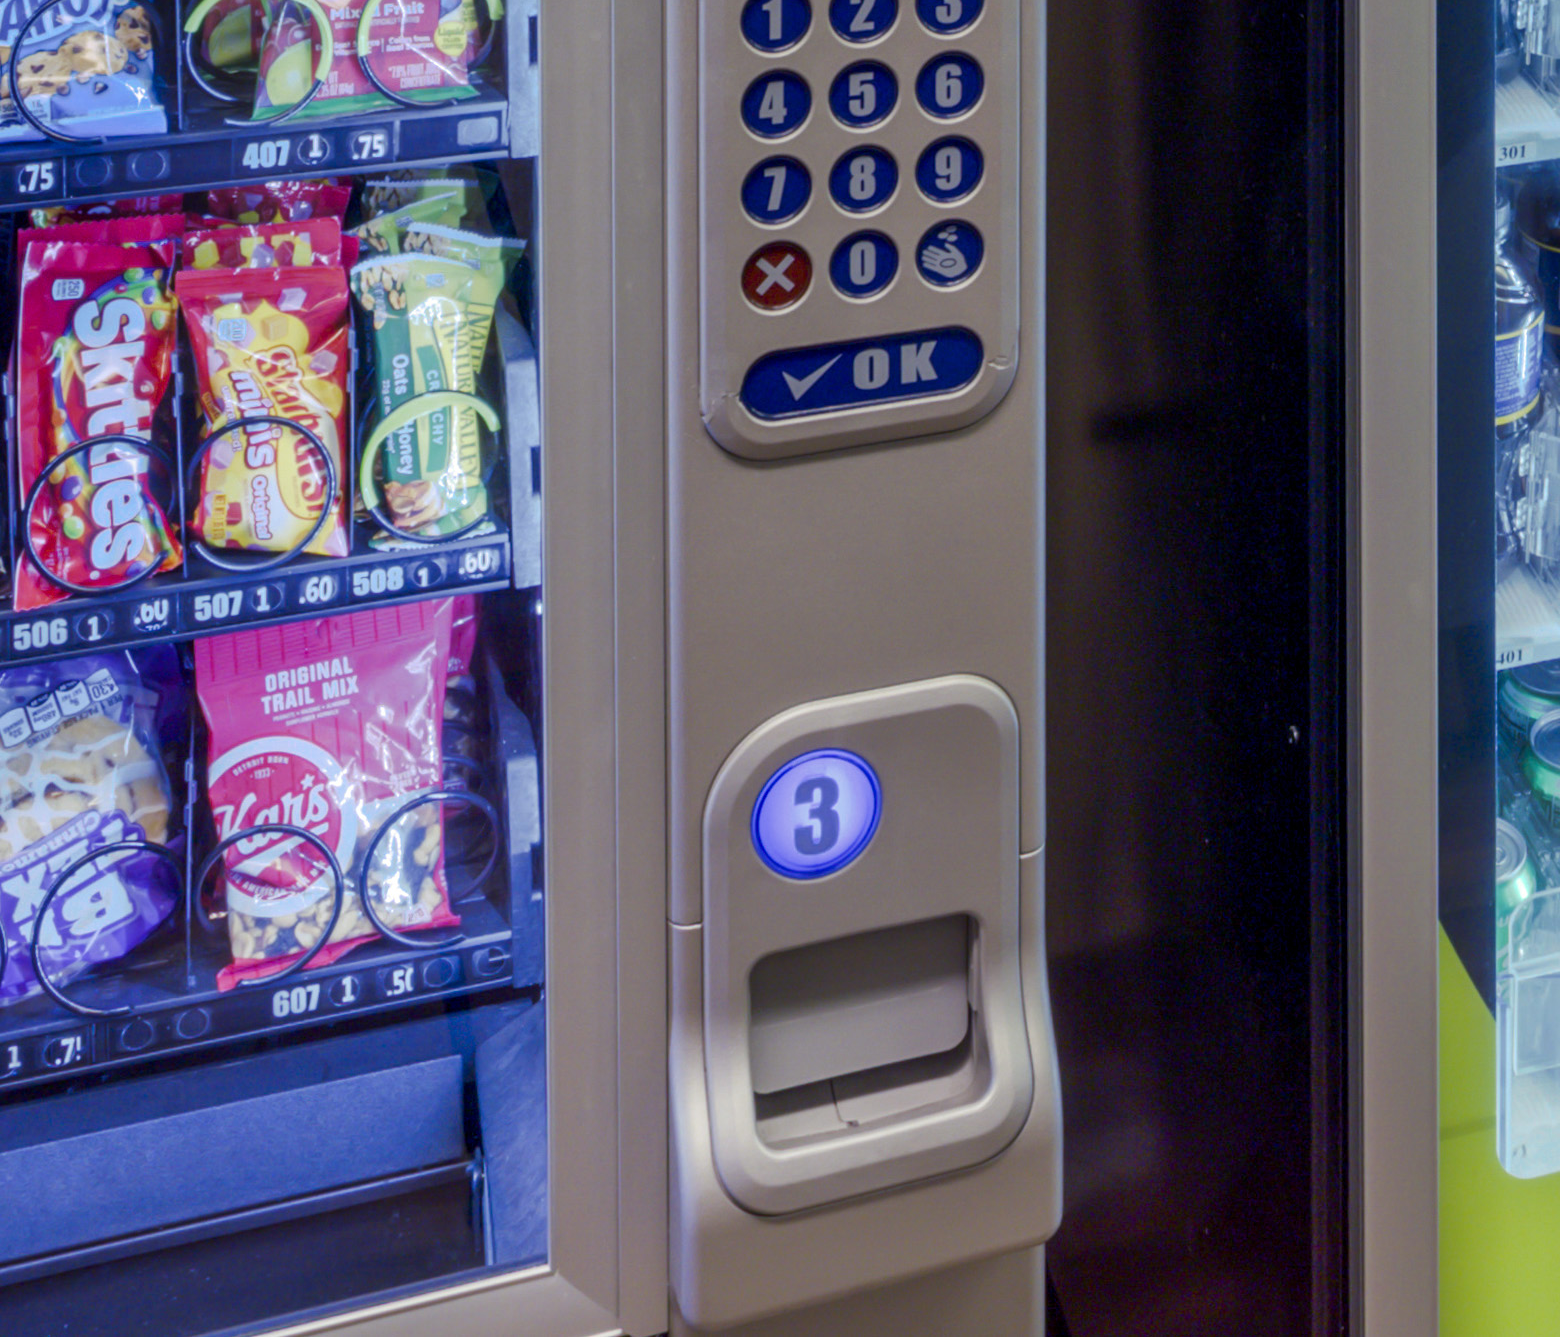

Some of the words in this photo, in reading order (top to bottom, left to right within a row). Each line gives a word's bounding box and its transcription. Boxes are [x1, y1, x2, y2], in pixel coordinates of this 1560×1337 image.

[757, 80, 787, 126] 4
[849, 71, 876, 118] 5
[934, 62, 963, 109] 6
[763, 165, 787, 213] 7
[848, 155, 876, 201] 8
[934, 146, 963, 192] 9
[848, 241, 876, 287] 0
[852, 340, 939, 391] OK
[73, 297, 152, 570] Skittles
[230, 370, 280, 469] minis
[251, 474, 274, 541] original
[352, 564, 404, 596] 508
[13, 618, 68, 651] 506
[261, 684, 318, 715] TRAIL
[321, 674, 360, 699] MIX
[264, 656, 354, 694] ORIGINAL
[793, 775, 841, 856] 3
[272, 985, 320, 1017] 607
